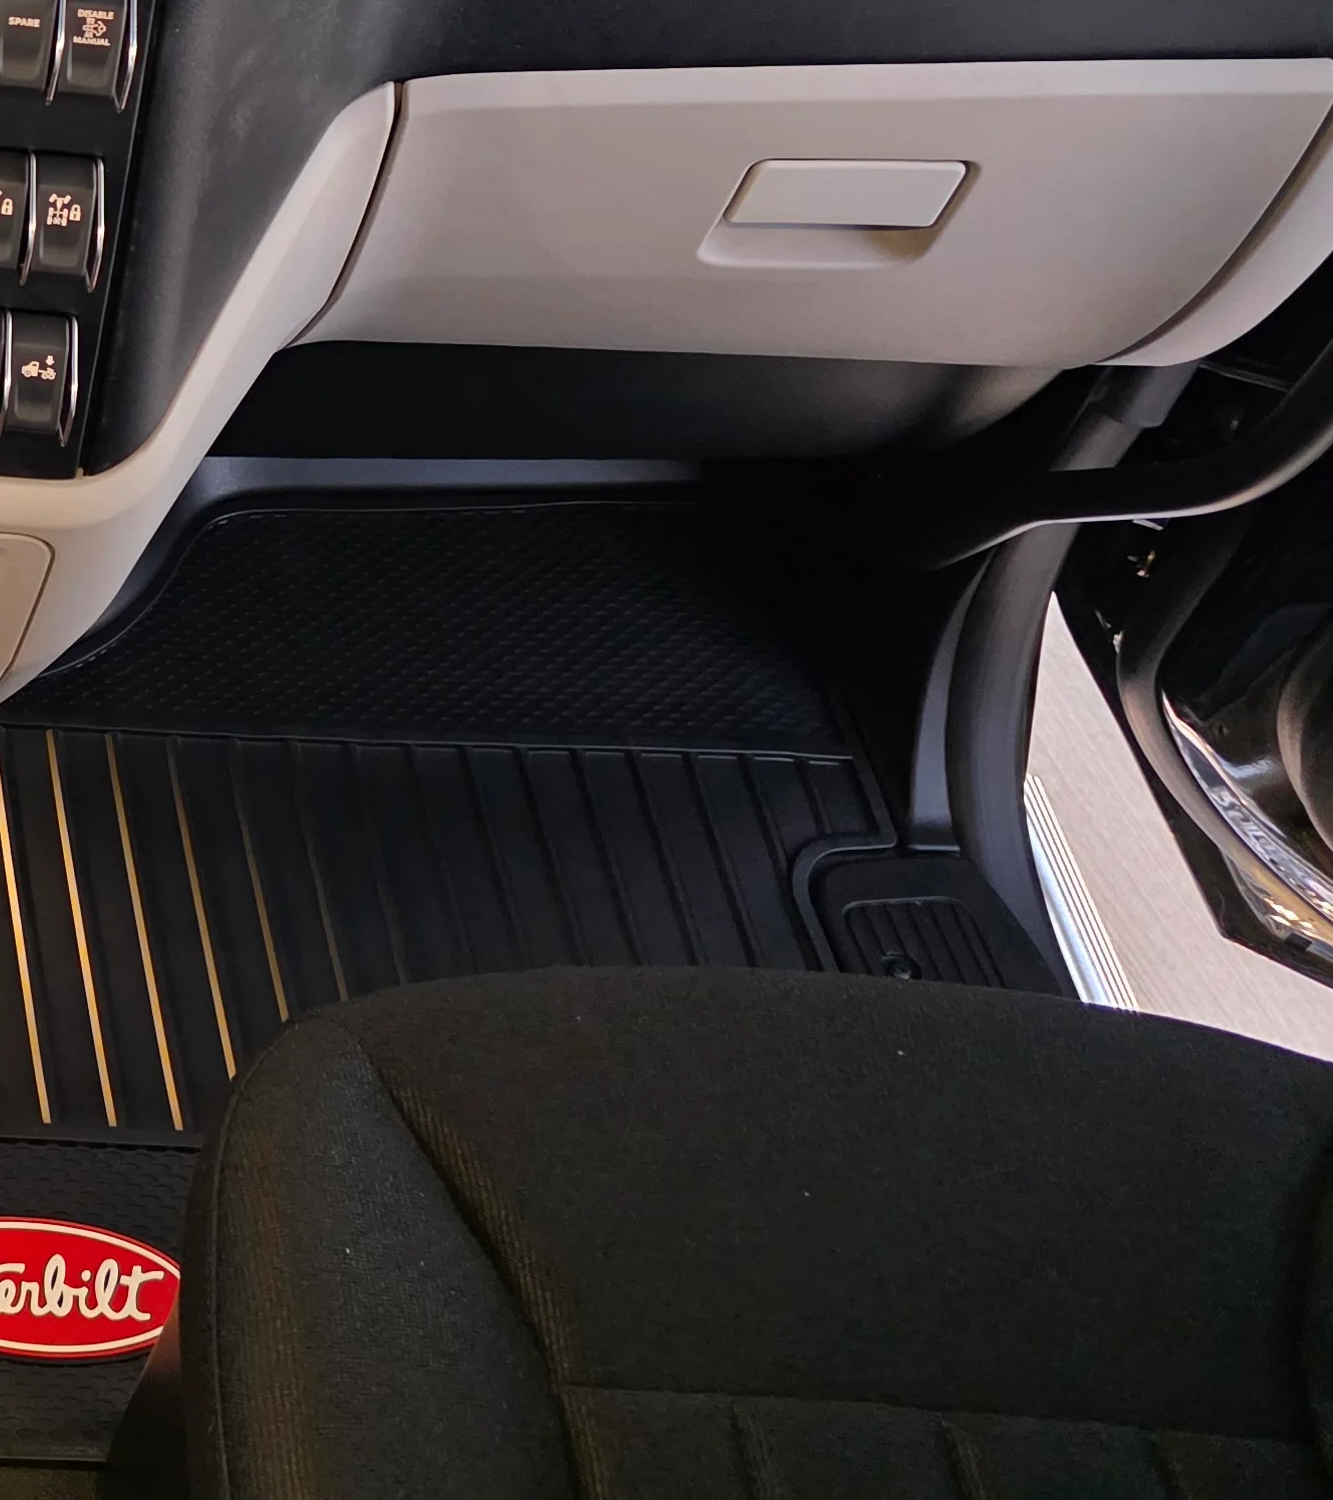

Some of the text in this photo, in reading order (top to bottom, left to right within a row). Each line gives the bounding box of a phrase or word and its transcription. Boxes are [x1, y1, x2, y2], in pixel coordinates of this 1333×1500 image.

[78, 9, 114, 20] DISABLE
[8, 16, 40, 28] SPARE
[73, 36, 110, 46] MANUAL
